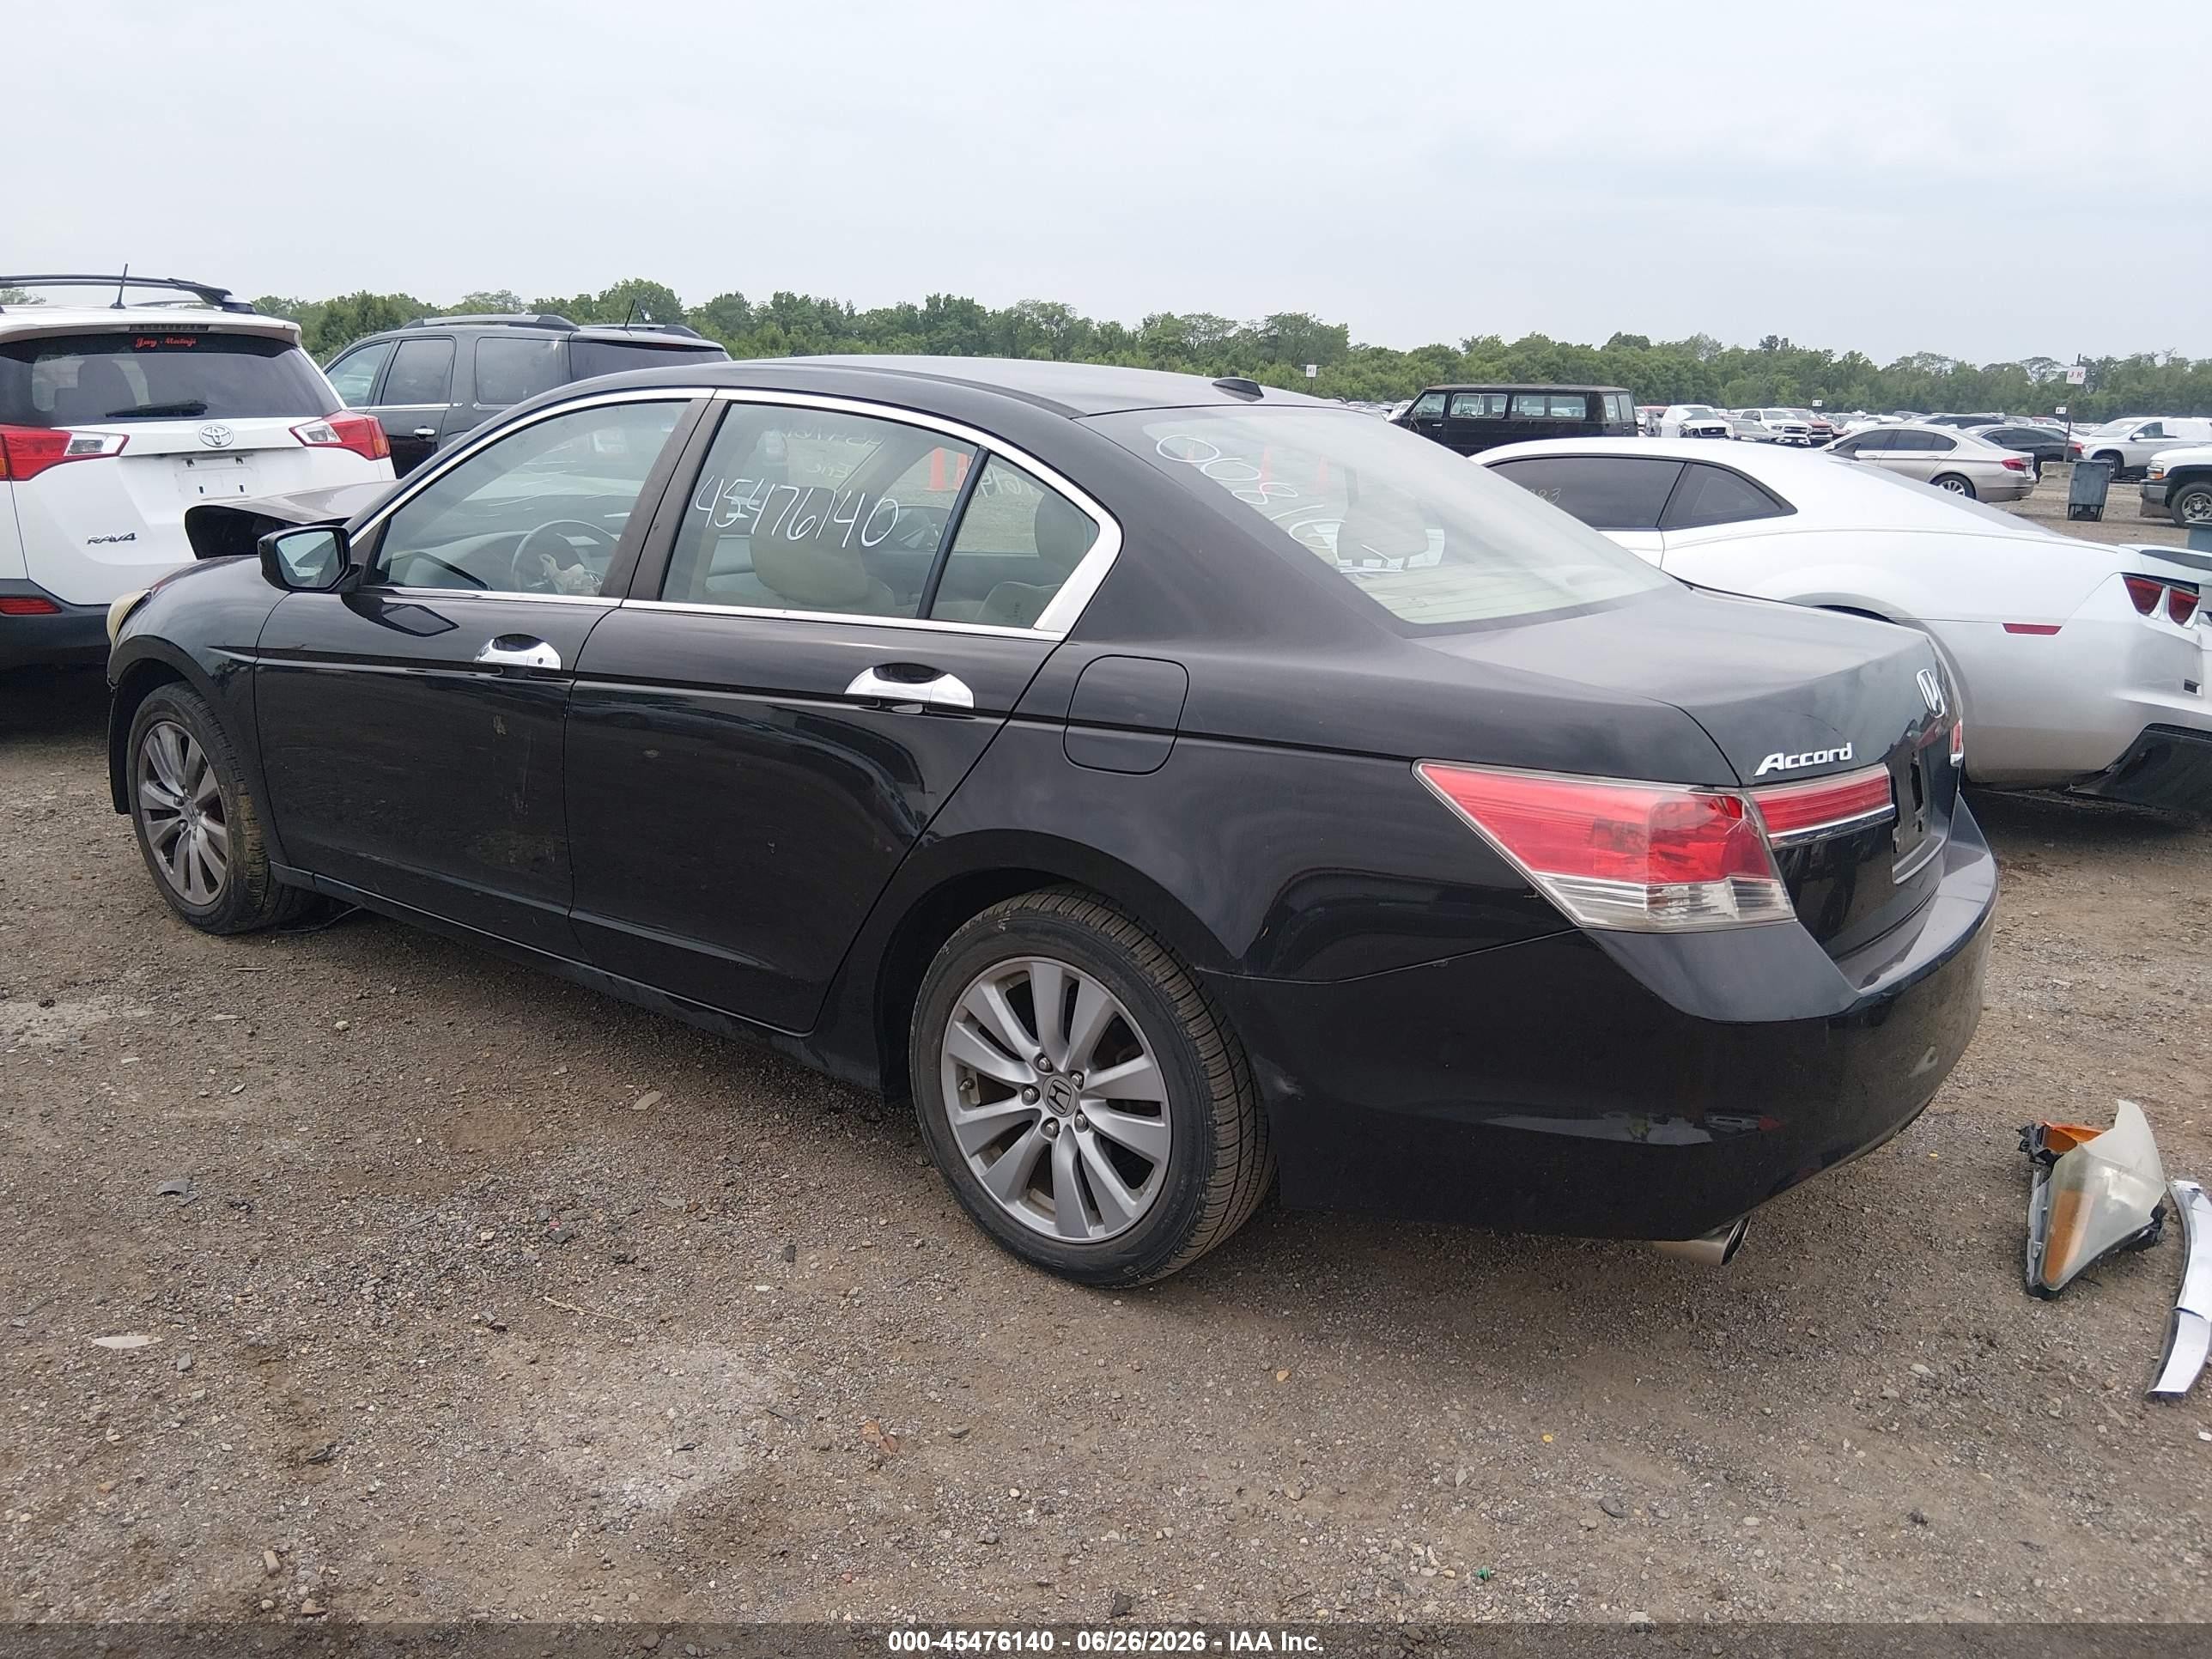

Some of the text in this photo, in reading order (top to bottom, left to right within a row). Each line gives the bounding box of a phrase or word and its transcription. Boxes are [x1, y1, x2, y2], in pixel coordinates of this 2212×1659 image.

[696, 474, 900, 549] 45476140
[87, 532, 137, 544] RAV4
[1753, 742, 1853, 777] Accord
